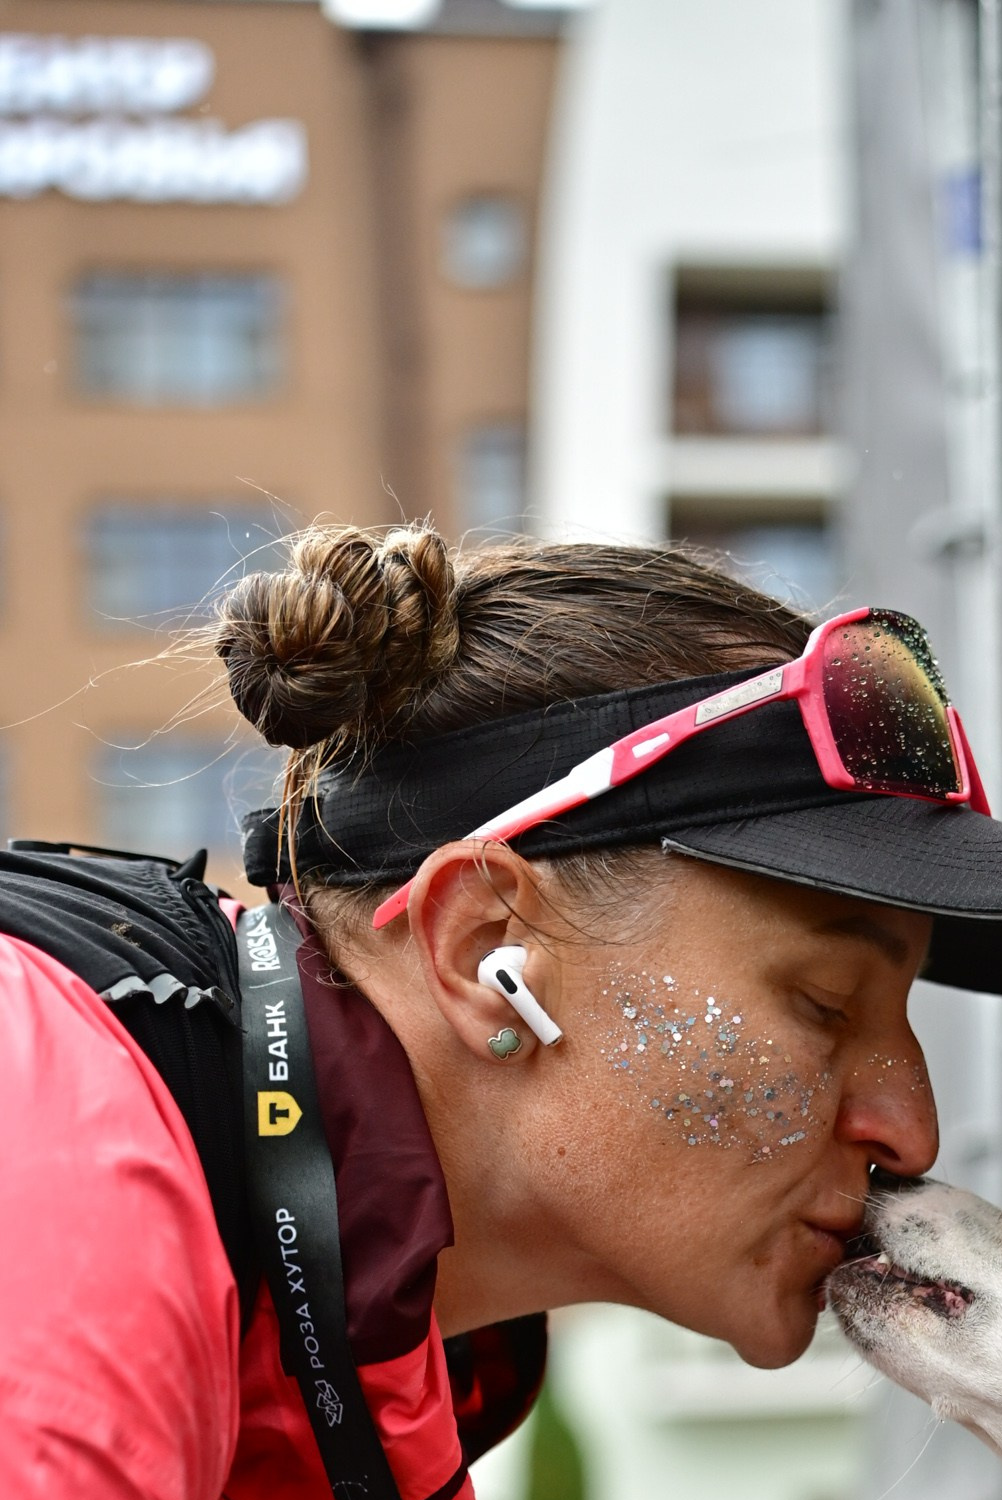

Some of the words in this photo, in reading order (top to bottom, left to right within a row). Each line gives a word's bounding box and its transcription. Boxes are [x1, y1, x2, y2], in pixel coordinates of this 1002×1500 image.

[246, 915, 281, 972] ROSA
[265, 1000, 289, 1081] БАНК
[276, 1208, 306, 1294] ХУТОР
[296, 1302, 325, 1369] РОЗА
